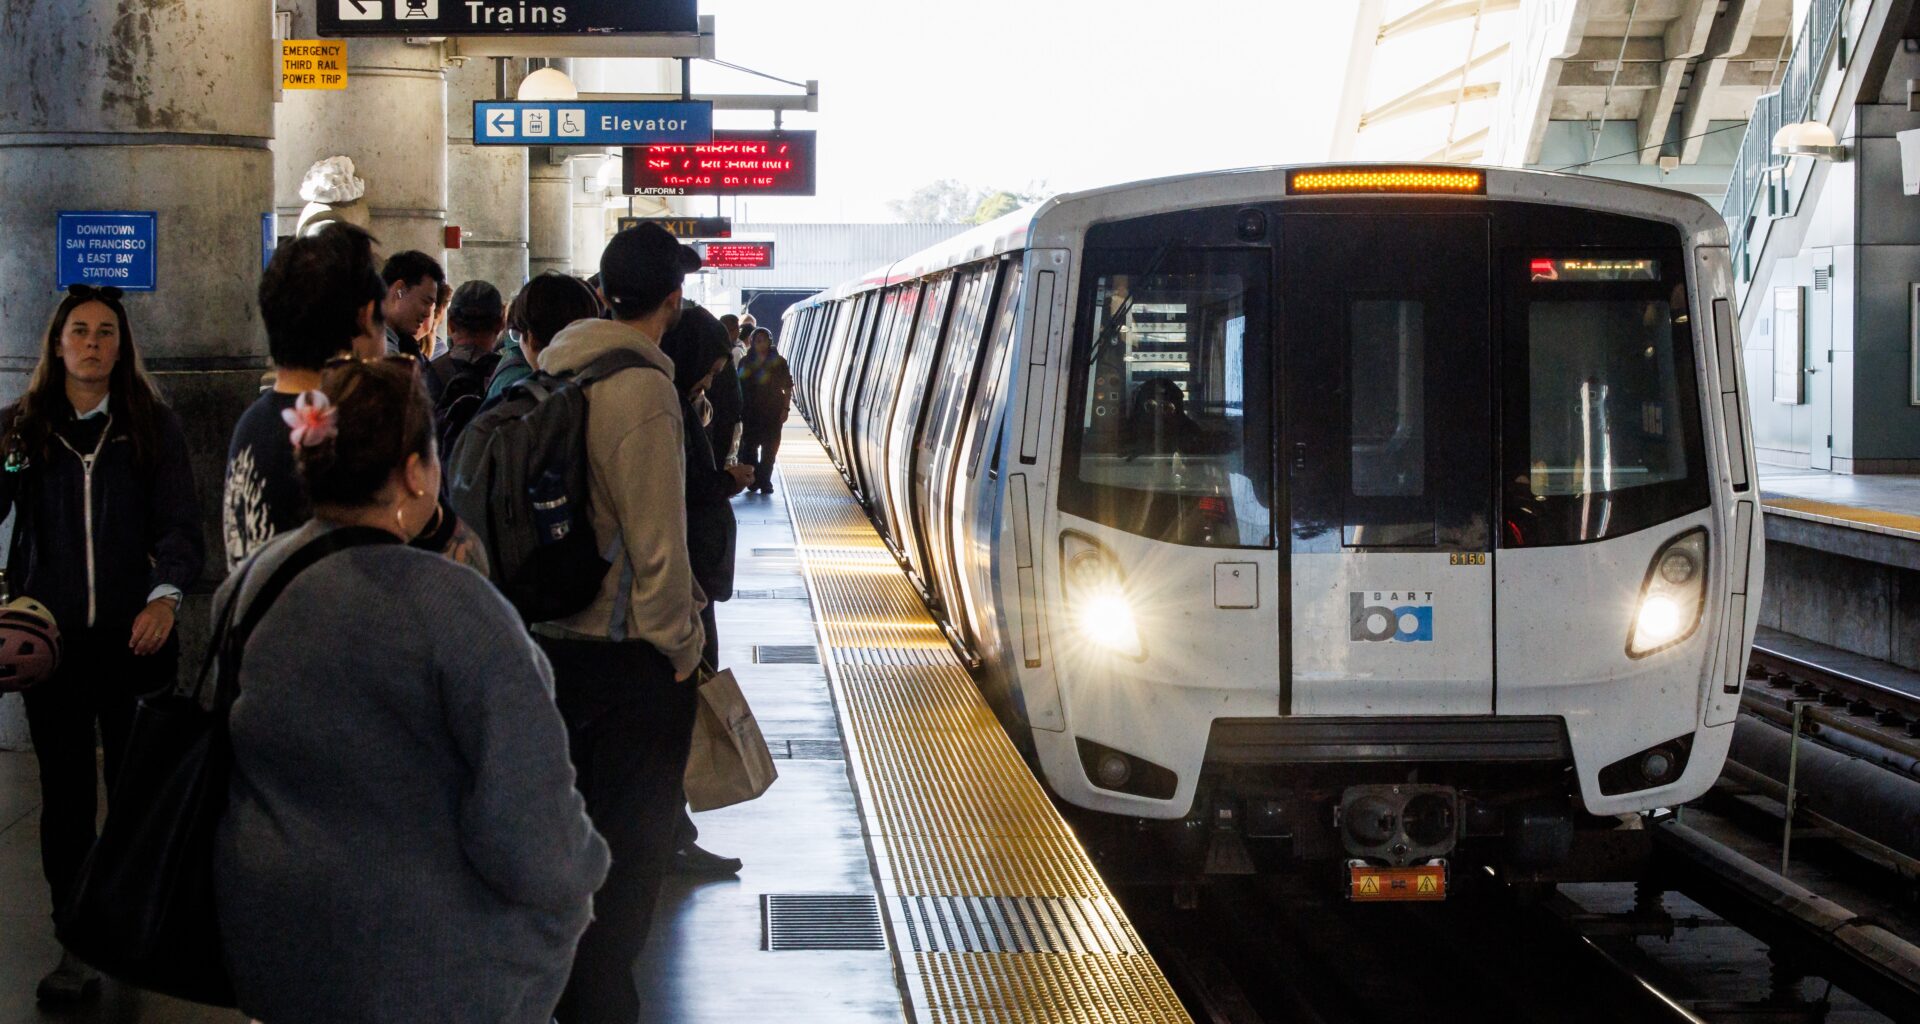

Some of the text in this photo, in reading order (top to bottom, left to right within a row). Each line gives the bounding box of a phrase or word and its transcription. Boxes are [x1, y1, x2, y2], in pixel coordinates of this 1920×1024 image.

[465, 1, 567, 24] Trains
[283, 46, 340, 56] EMERGENCY
[285, 60, 339, 70] THIRD RAIL
[283, 74, 342, 84] POWER TRIP
[601, 116, 688, 131] Elevator
[77, 225, 135, 235] DOWNTOWN
[656, 221, 697, 235] XIT
[66, 239, 146, 249] SAN FRANCISCO
[77, 253, 134, 263] & EAST BAY
[82, 268, 129, 278] STATIONS
[1450, 553, 1485, 565] 3150
[1373, 591, 1433, 601] BART
